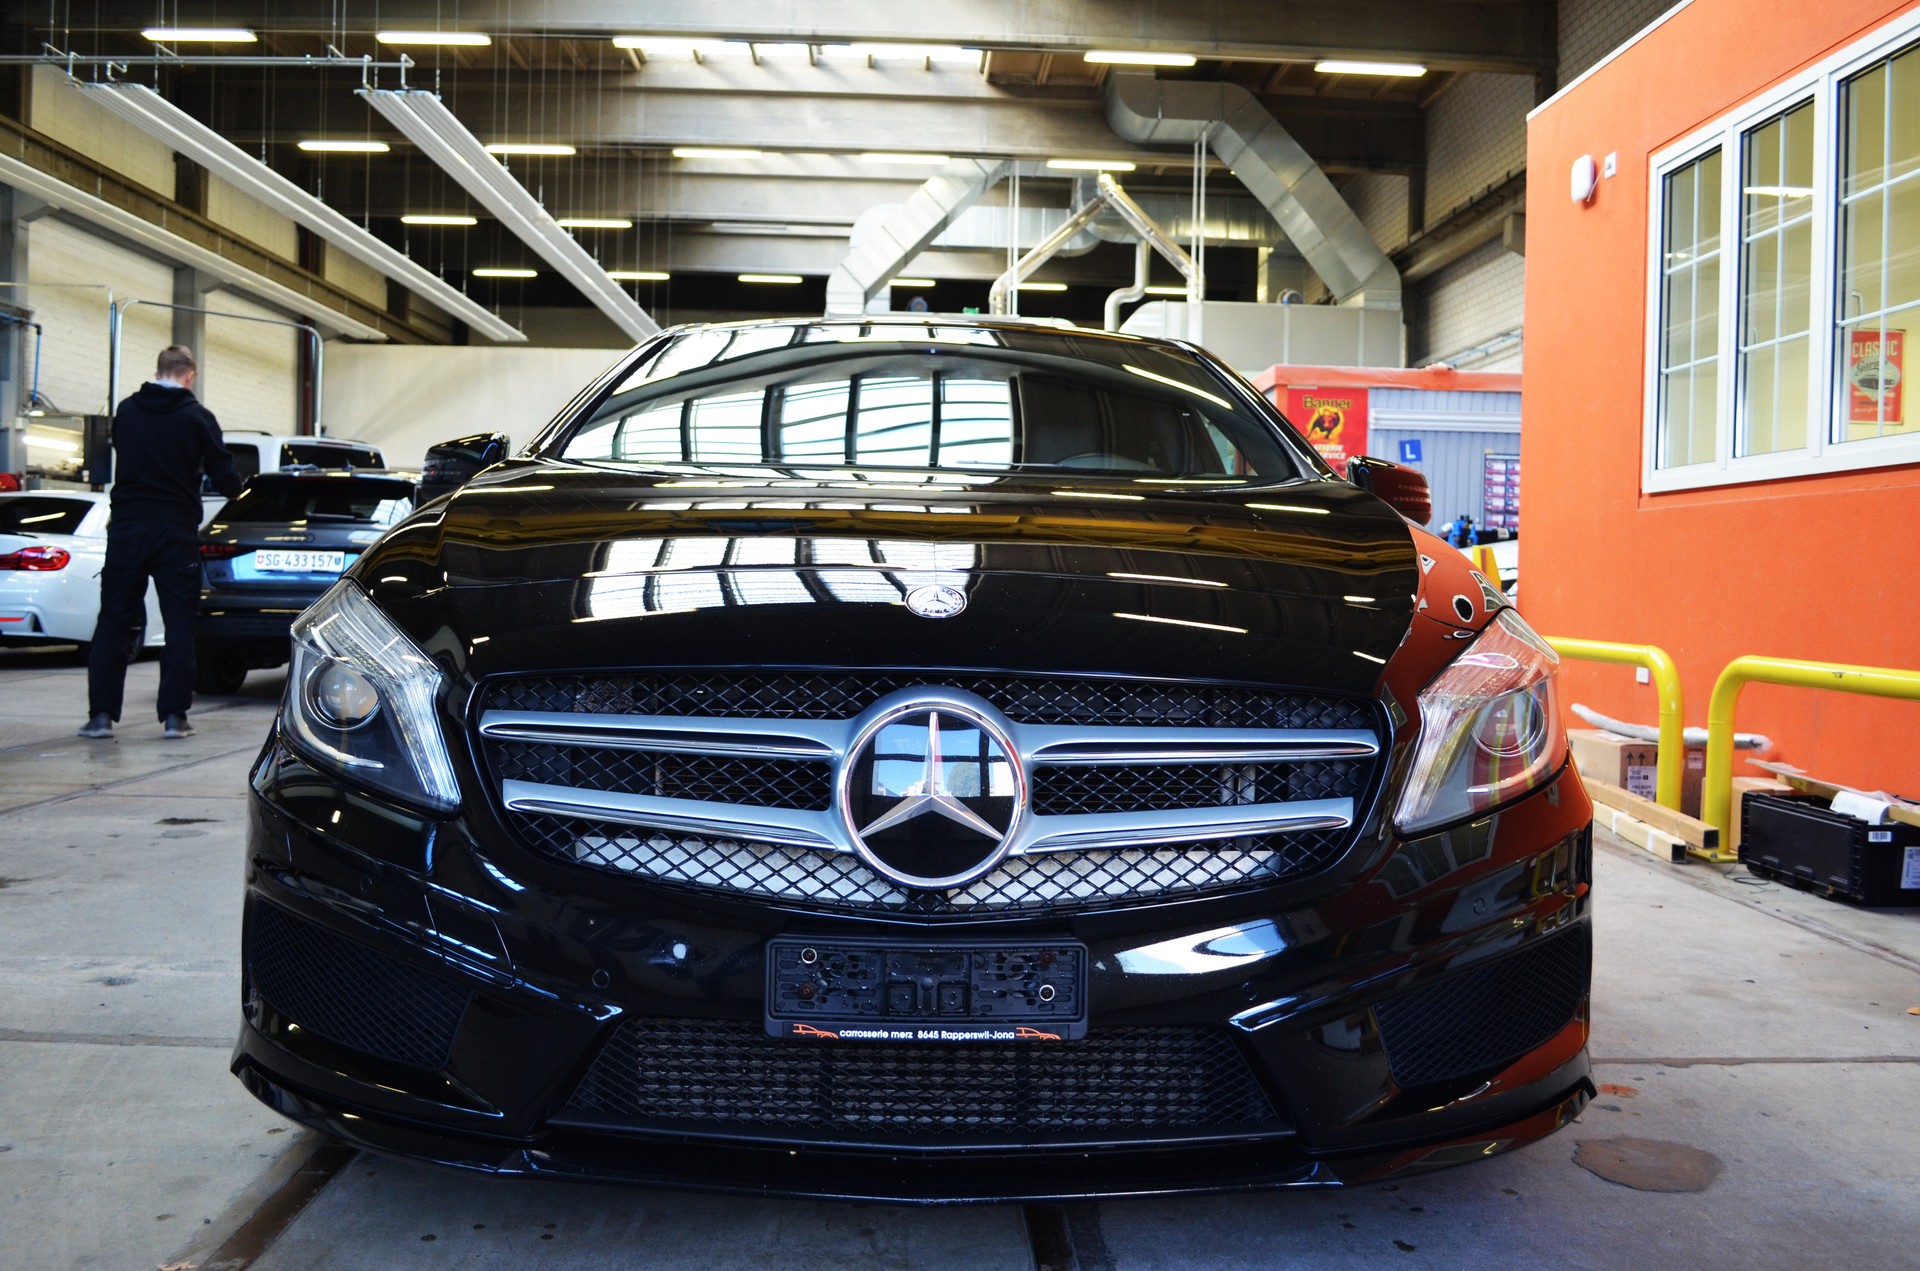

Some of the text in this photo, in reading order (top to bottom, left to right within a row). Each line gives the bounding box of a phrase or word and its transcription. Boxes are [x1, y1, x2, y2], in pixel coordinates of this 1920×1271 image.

[1852, 340, 1898, 358] CLASIC
[1304, 395, 1352, 409] Banner
[1405, 443, 1416, 459] L
[839, 1029, 1015, 1040] carrosserie merz 8645 Rapperswil-Jona
